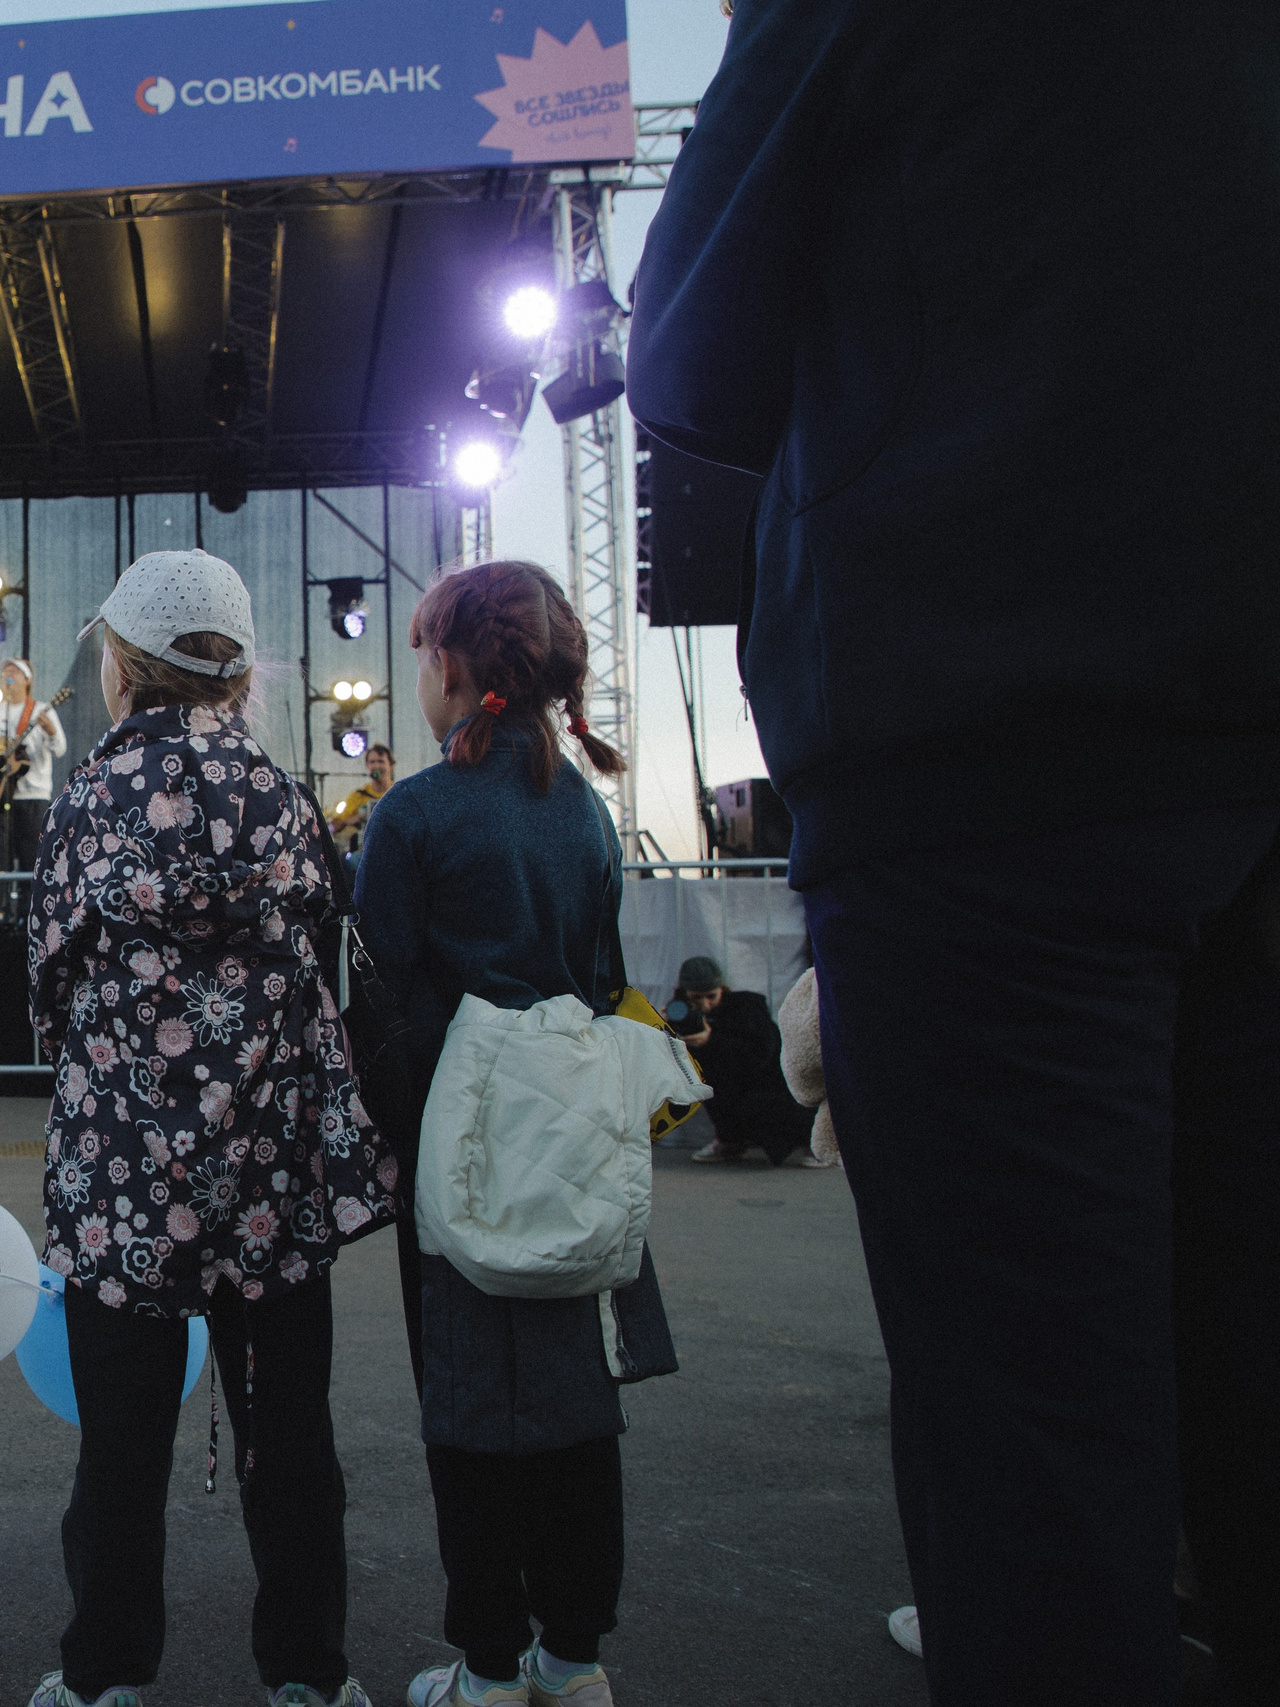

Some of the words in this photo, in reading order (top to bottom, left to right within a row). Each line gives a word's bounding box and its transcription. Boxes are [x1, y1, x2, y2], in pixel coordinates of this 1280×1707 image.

[180, 64, 442, 107] СОВКОМБАНК
[514, 96, 550, 114] ВСЕ
[528, 100, 620, 127] СОШЛИСЬ
